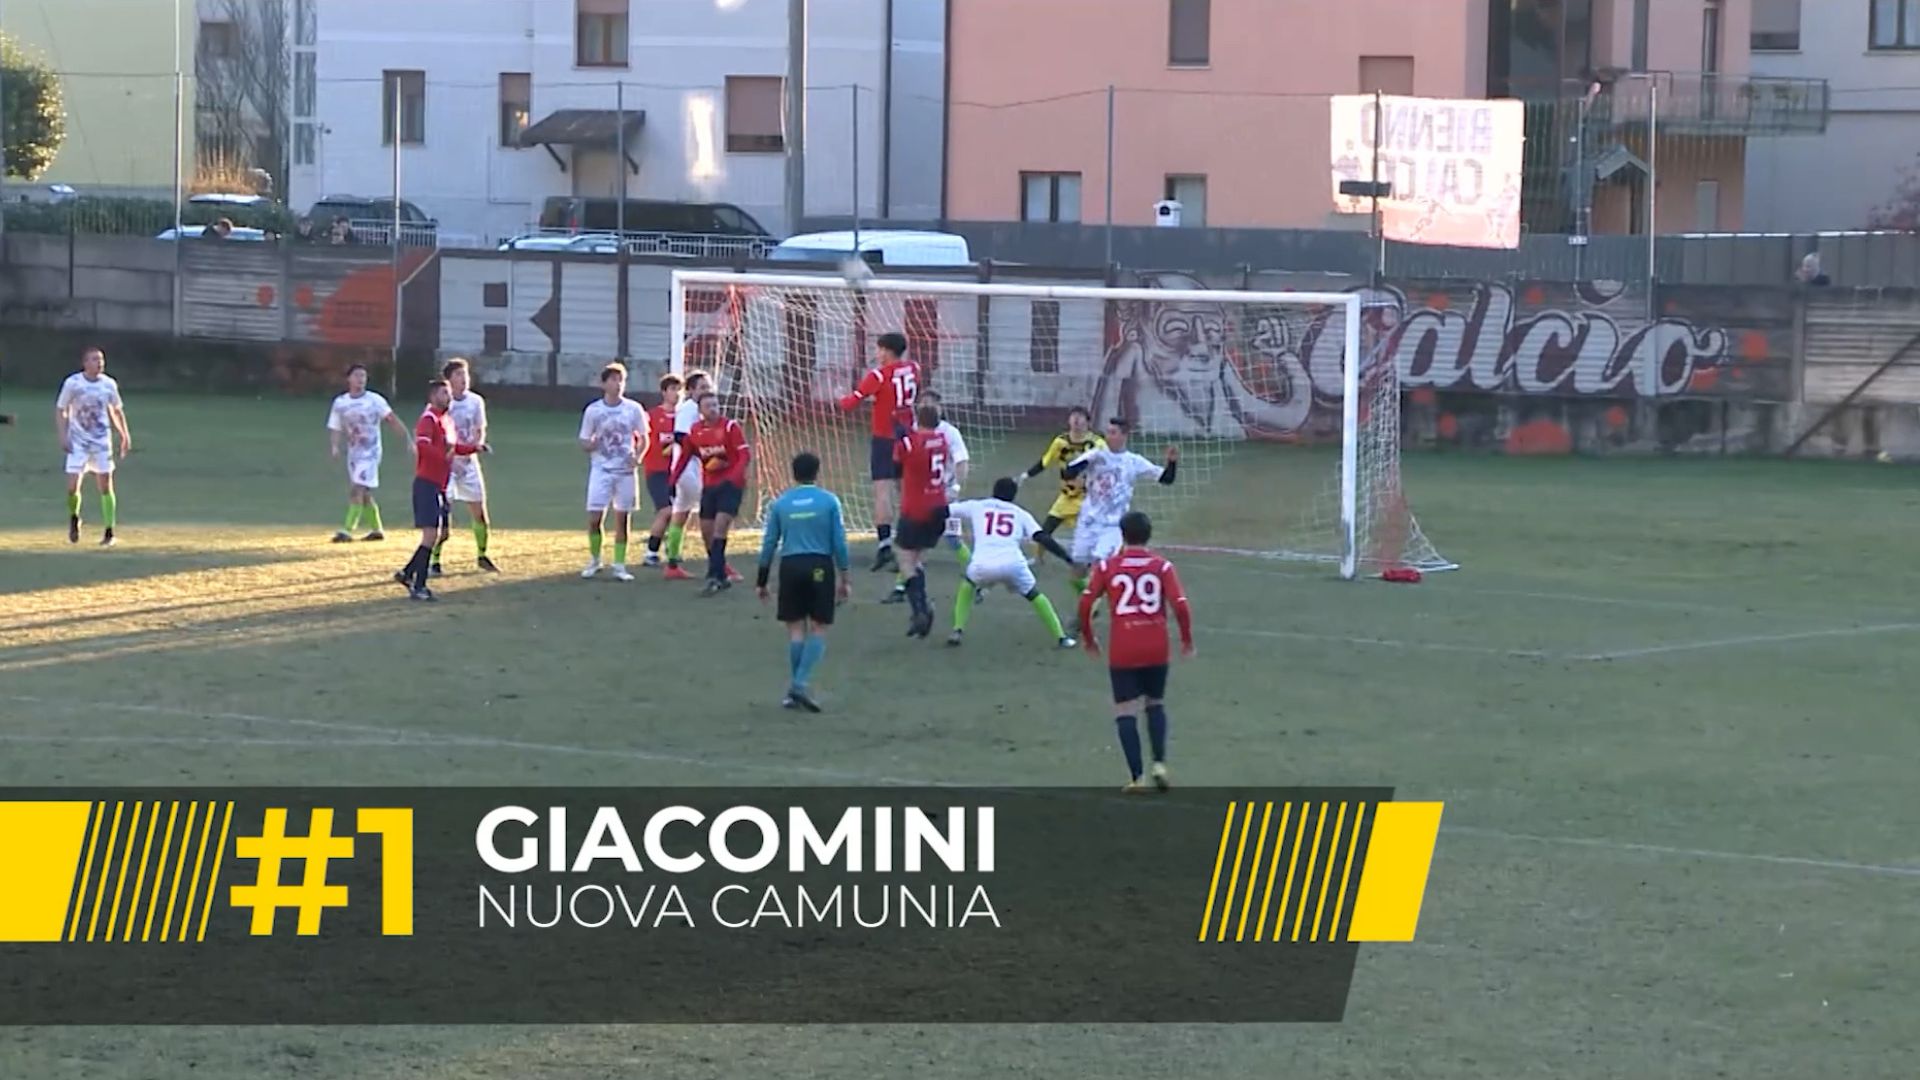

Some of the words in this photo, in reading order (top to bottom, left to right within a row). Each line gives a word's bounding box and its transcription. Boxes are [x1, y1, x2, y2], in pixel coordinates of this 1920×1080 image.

[891, 373, 918, 408] 15
[930, 452, 946, 487] 5
[983, 511, 1015, 537] 15
[1111, 573, 1162, 615] 29
